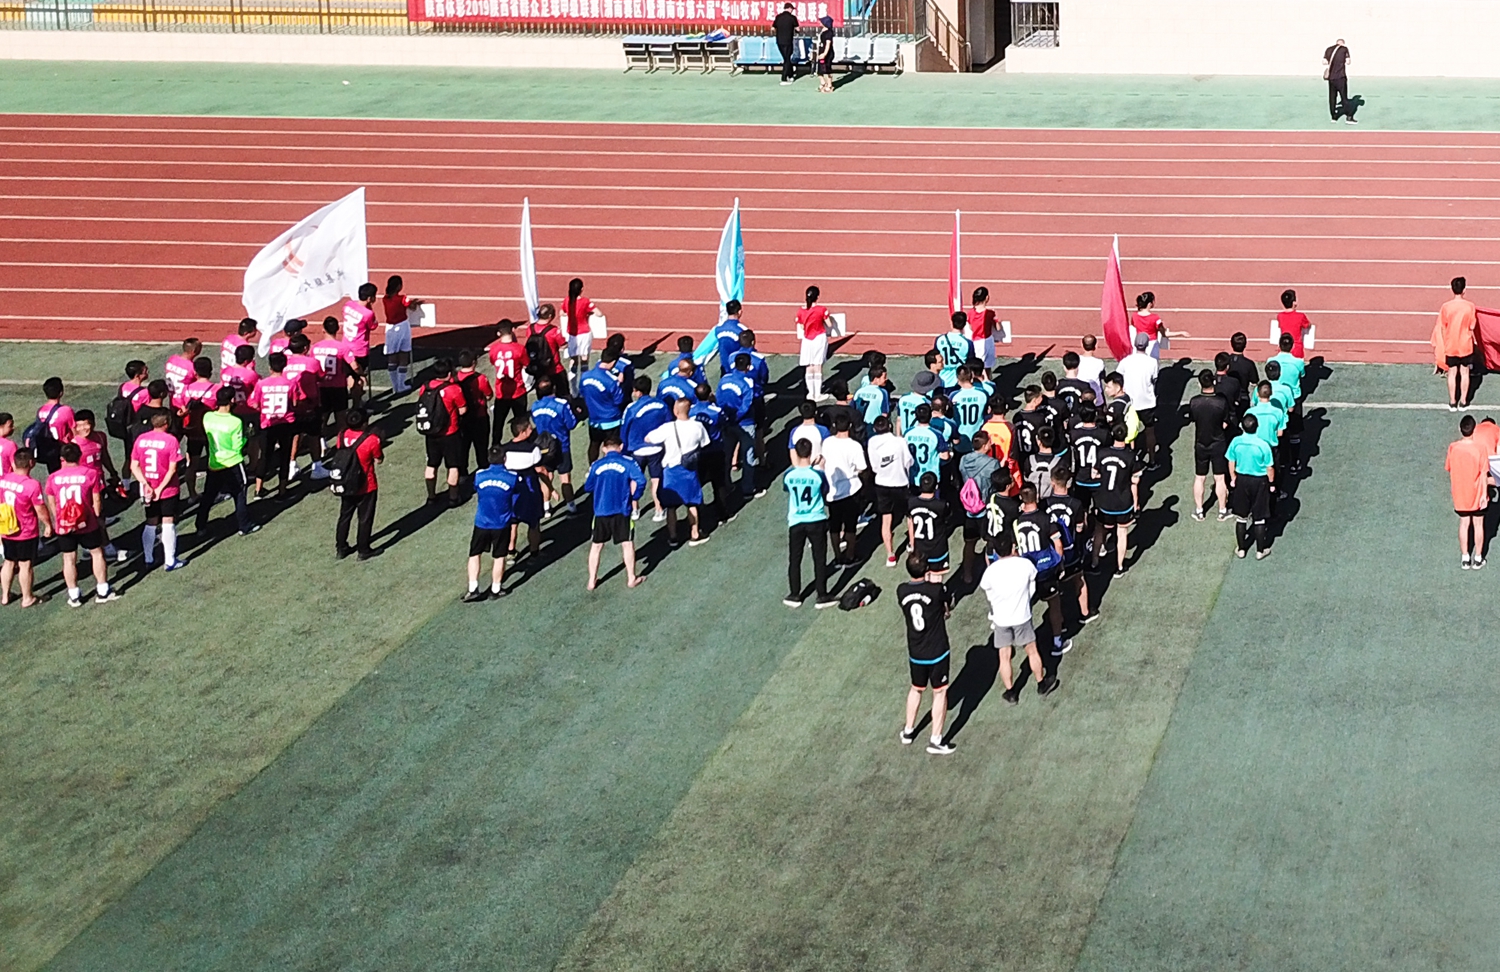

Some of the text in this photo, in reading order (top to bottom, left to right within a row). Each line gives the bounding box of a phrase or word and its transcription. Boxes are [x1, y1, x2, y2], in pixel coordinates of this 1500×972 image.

[495, 359, 514, 378] 21
[261, 393, 288, 414] 39
[961, 404, 979, 425] 10
[144, 449, 157, 472] 3
[1077, 445, 1097, 468] 14
[1106, 465, 1117, 490] 7
[792, 485, 813, 507] 14
[913, 517, 934, 540] 21
[910, 602, 925, 631] 8
